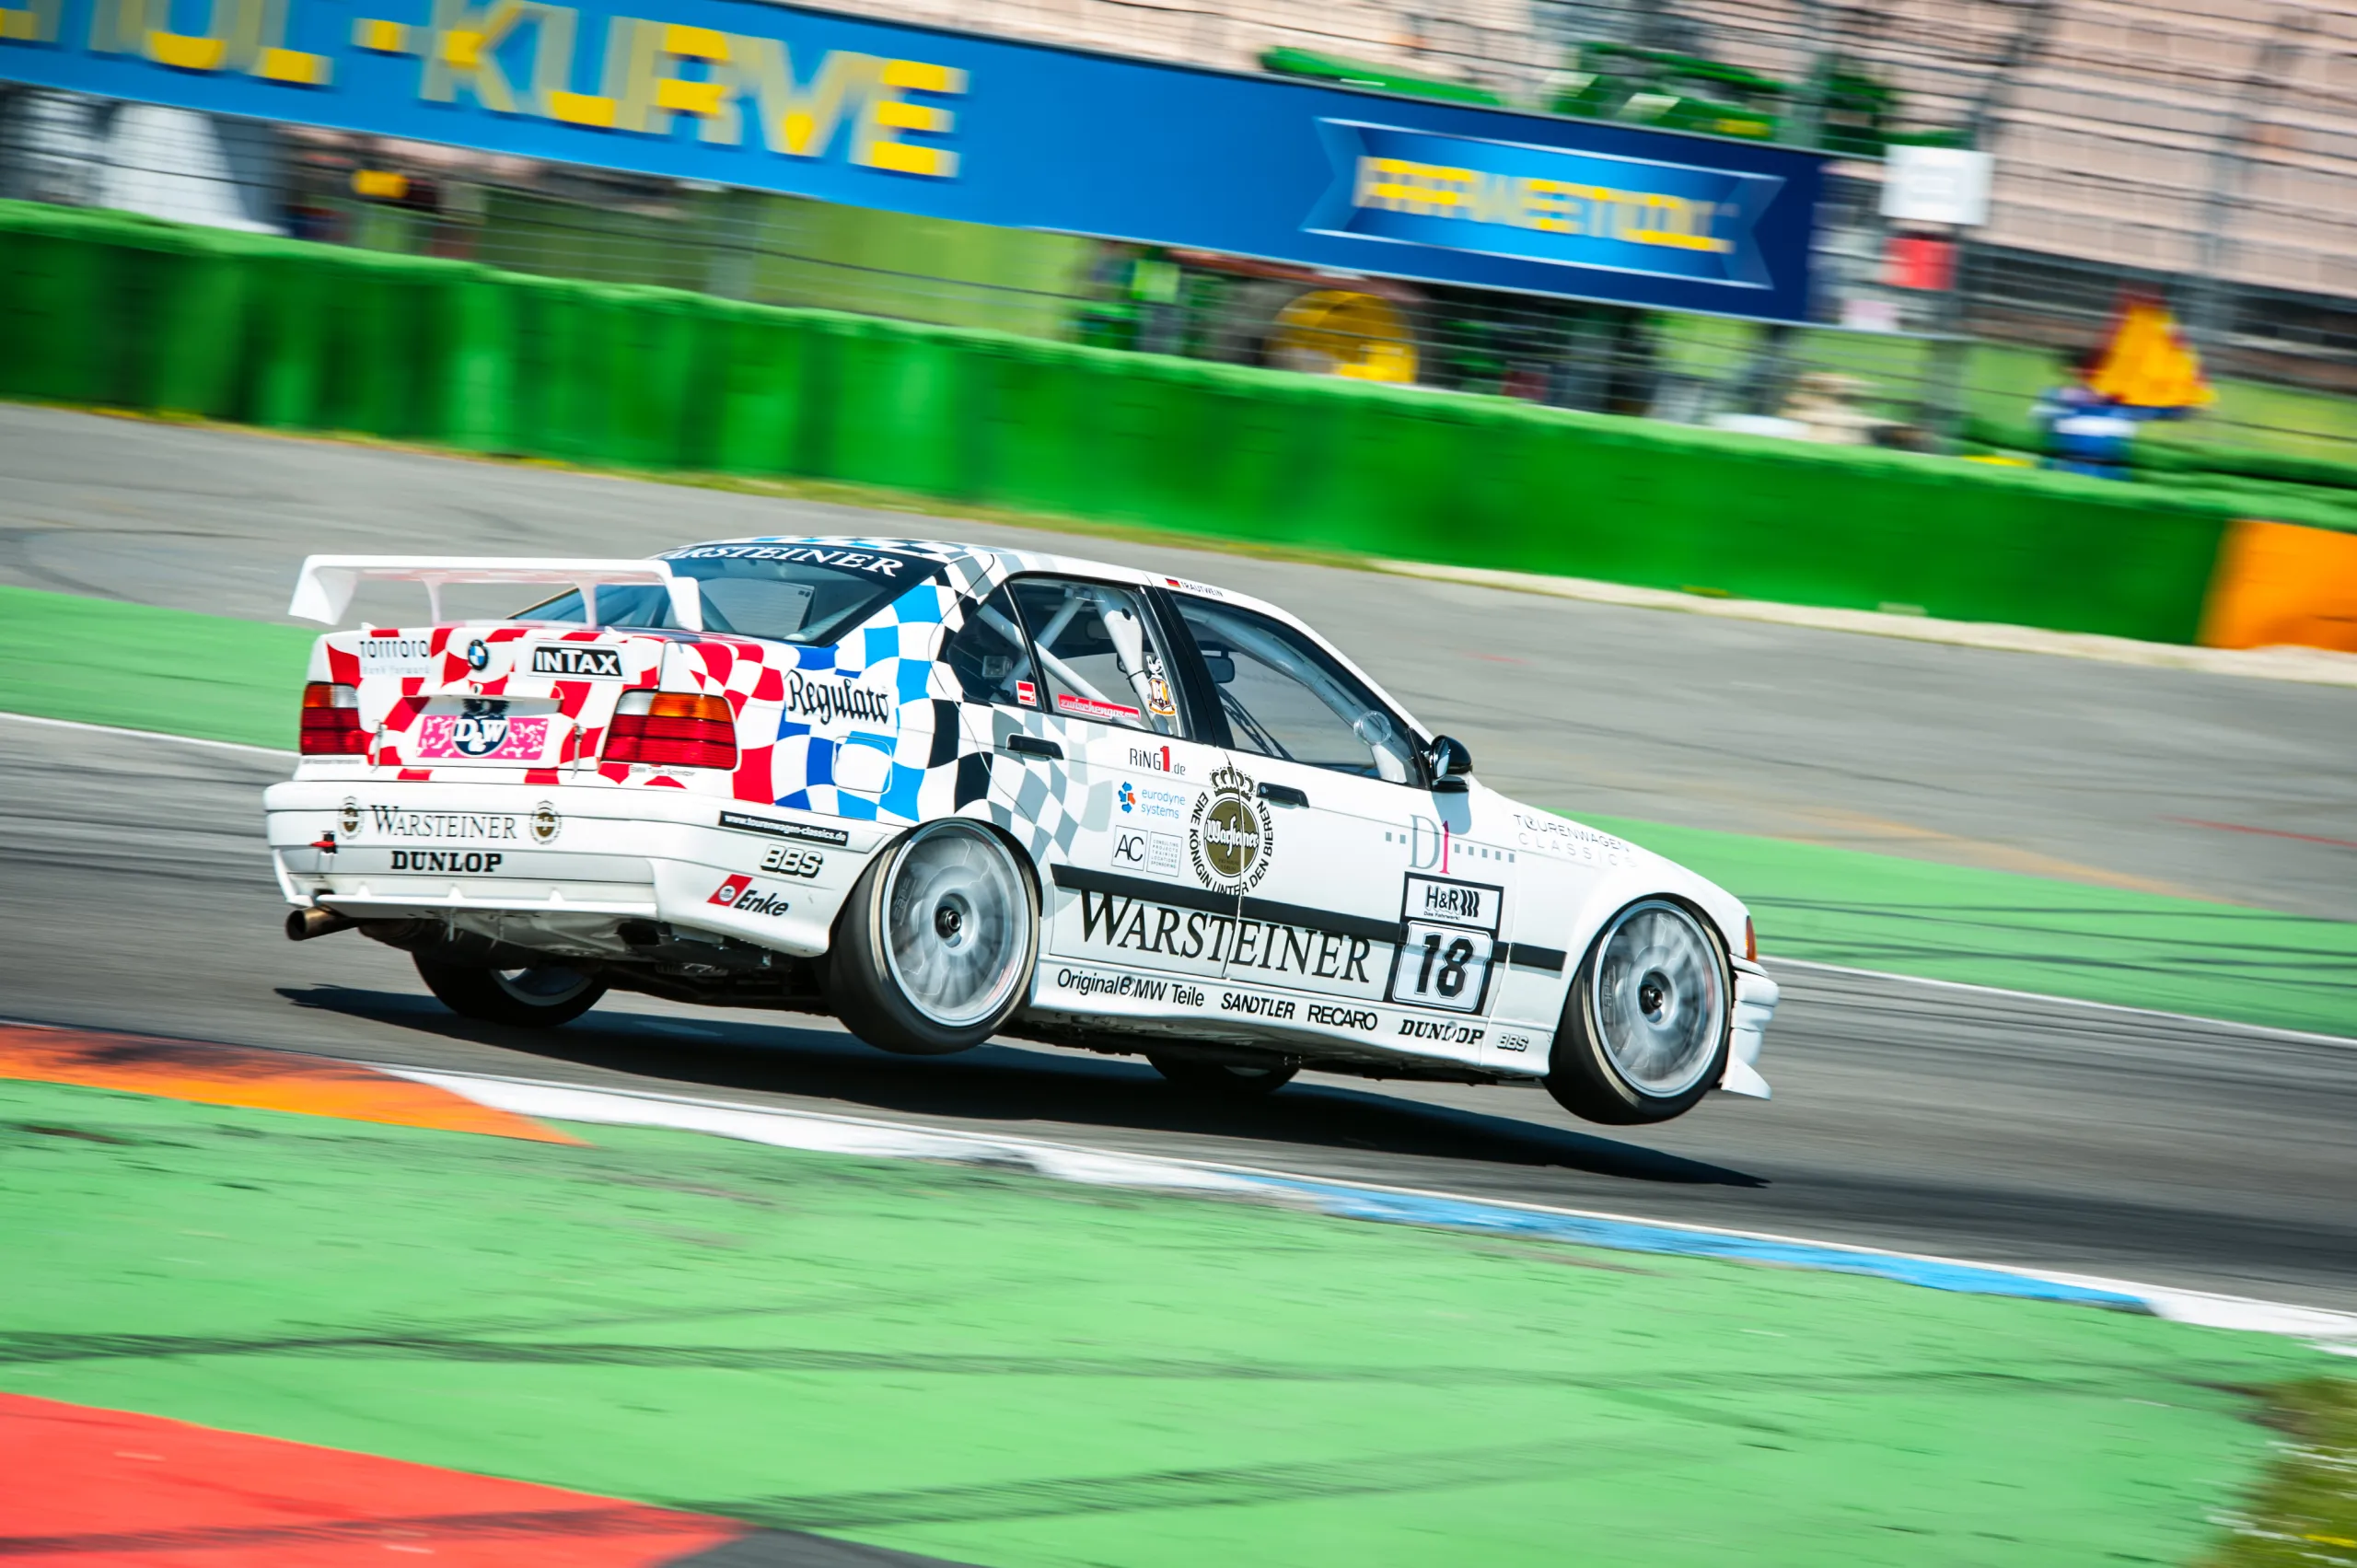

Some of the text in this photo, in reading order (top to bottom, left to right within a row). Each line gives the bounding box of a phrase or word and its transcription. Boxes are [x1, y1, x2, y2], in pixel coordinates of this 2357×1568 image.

[663, 545, 904, 577] ARSTEINER
[535, 648, 620, 675] INTAX
[1141, 788, 1186, 806] eurodyne
[1141, 803, 1179, 819] systems
[1190, 792, 1209, 826] EINE
[370, 805, 517, 840] WARSTEINER
[1257, 800, 1273, 857] BIEREN
[391, 850, 502, 872] DUNLOP
[760, 844, 823, 878] BBS
[1114, 834, 1144, 863] AC
[1190, 828, 1213, 889] KÖNIGIN
[1518, 832, 1638, 868] CLASSICS
[1213, 880, 1249, 896] UNTER
[1249, 859, 1270, 888] DEN
[733, 889, 790, 917] Enke
[1425, 885, 1460, 913] H&R
[1081, 890, 1370, 983] WARSTEINER
[1414, 932, 1476, 999] 18
[1057, 968, 1204, 1007] Original BMW Teile
[1221, 992, 1296, 1020] SANDTLER
[1307, 1005, 1377, 1031] RECARO
[1398, 1018, 1485, 1045] DUNLOP
[1496, 1032, 1529, 1052] BBS
